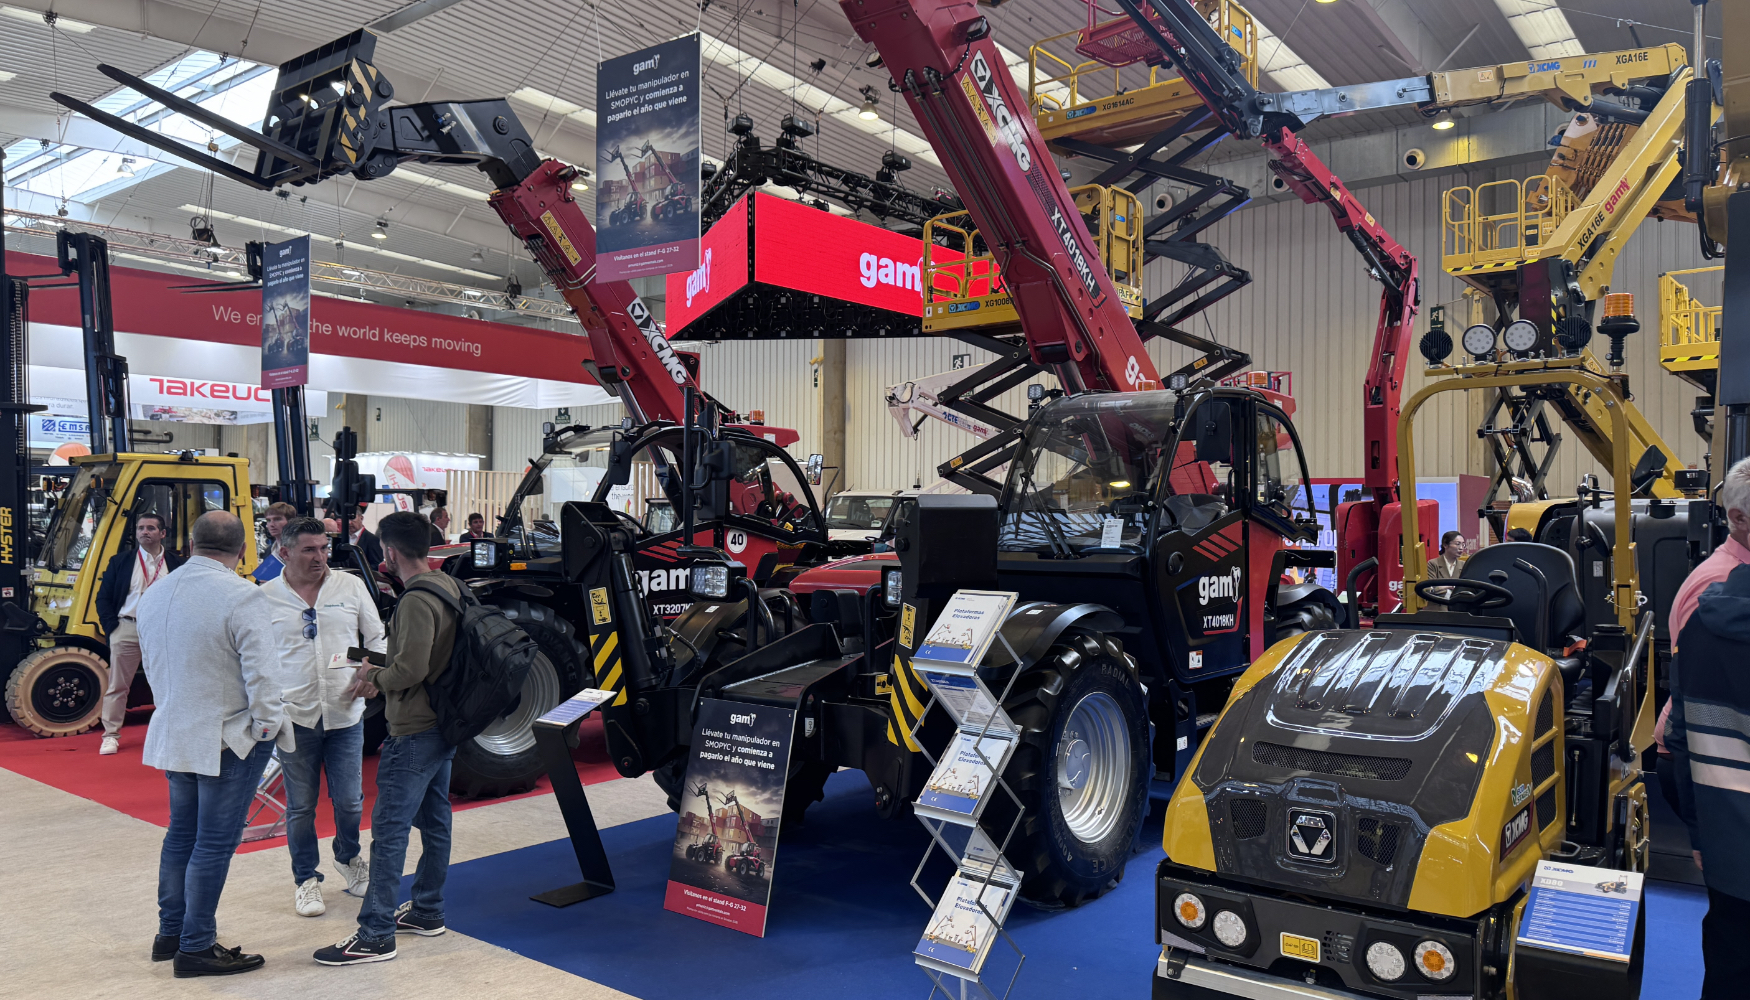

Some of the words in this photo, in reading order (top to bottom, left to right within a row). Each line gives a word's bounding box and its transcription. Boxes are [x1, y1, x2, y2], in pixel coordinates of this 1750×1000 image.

[1536, 62, 1560, 72] XCMG
[1616, 52, 1648, 65] XGA16E
[606, 87, 628, 99] Llévate
[638, 73, 679, 90] manipulador
[680, 70, 689, 78] en
[608, 110, 632, 123] pagarlo
[633, 106, 639, 115] el
[640, 104, 652, 114] año
[654, 100, 666, 110] que
[668, 96, 687, 106] viene
[610, 96, 638, 110] SMOPYC
[640, 95, 644, 103] y
[646, 86, 678, 100] comienza
[1102, 98, 1134, 110] XG1614AC
[983, 82, 1031, 172] XCMG
[1577, 211, 1605, 250] XGA16E
[212, 304, 241, 323] We
[309, 318, 332, 334] the
[336, 325, 379, 341] world
[384, 328, 428, 348] keeps
[432, 337, 481, 357] moving
[638, 320, 687, 384] XCMG
[0, 507, 13, 564] HYSTER
[731, 534, 744, 546] 40
[1198, 576, 1233, 606] gam
[1203, 614, 1234, 628] XT4018KH
[702, 728, 723, 738] Llévate
[732, 734, 771, 746] manipulador
[705, 740, 731, 750] SMOPYC
[738, 746, 767, 757] comienza
[700, 751, 723, 761] pagarlo
[731, 756, 742, 764] año
[757, 760, 775, 770] viene
[1512, 810, 1528, 842] XCMG
[734, 903, 746, 912] 27-32
